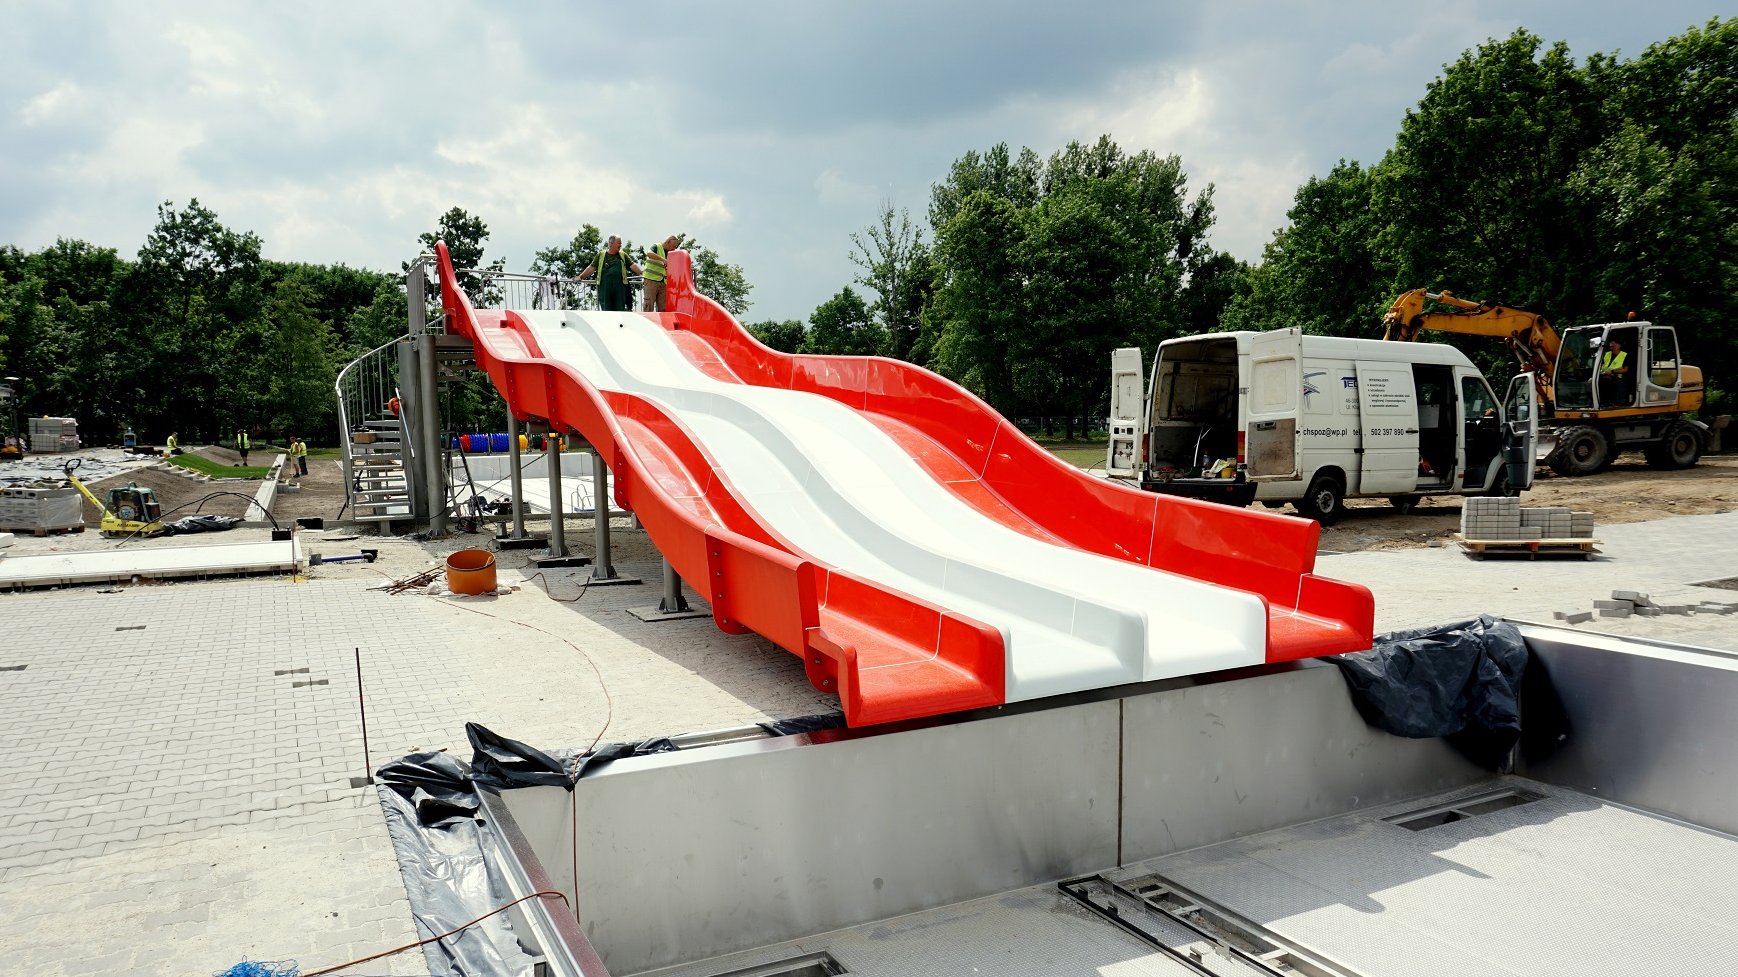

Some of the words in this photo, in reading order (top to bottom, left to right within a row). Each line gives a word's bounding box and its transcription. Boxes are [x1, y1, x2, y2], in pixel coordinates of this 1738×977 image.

[1303, 428, 1348, 438] chspoz@wp.pl
[1370, 428, 1382, 436] 502
[1382, 428, 1393, 436] 397
[1393, 428, 1404, 436] 890
